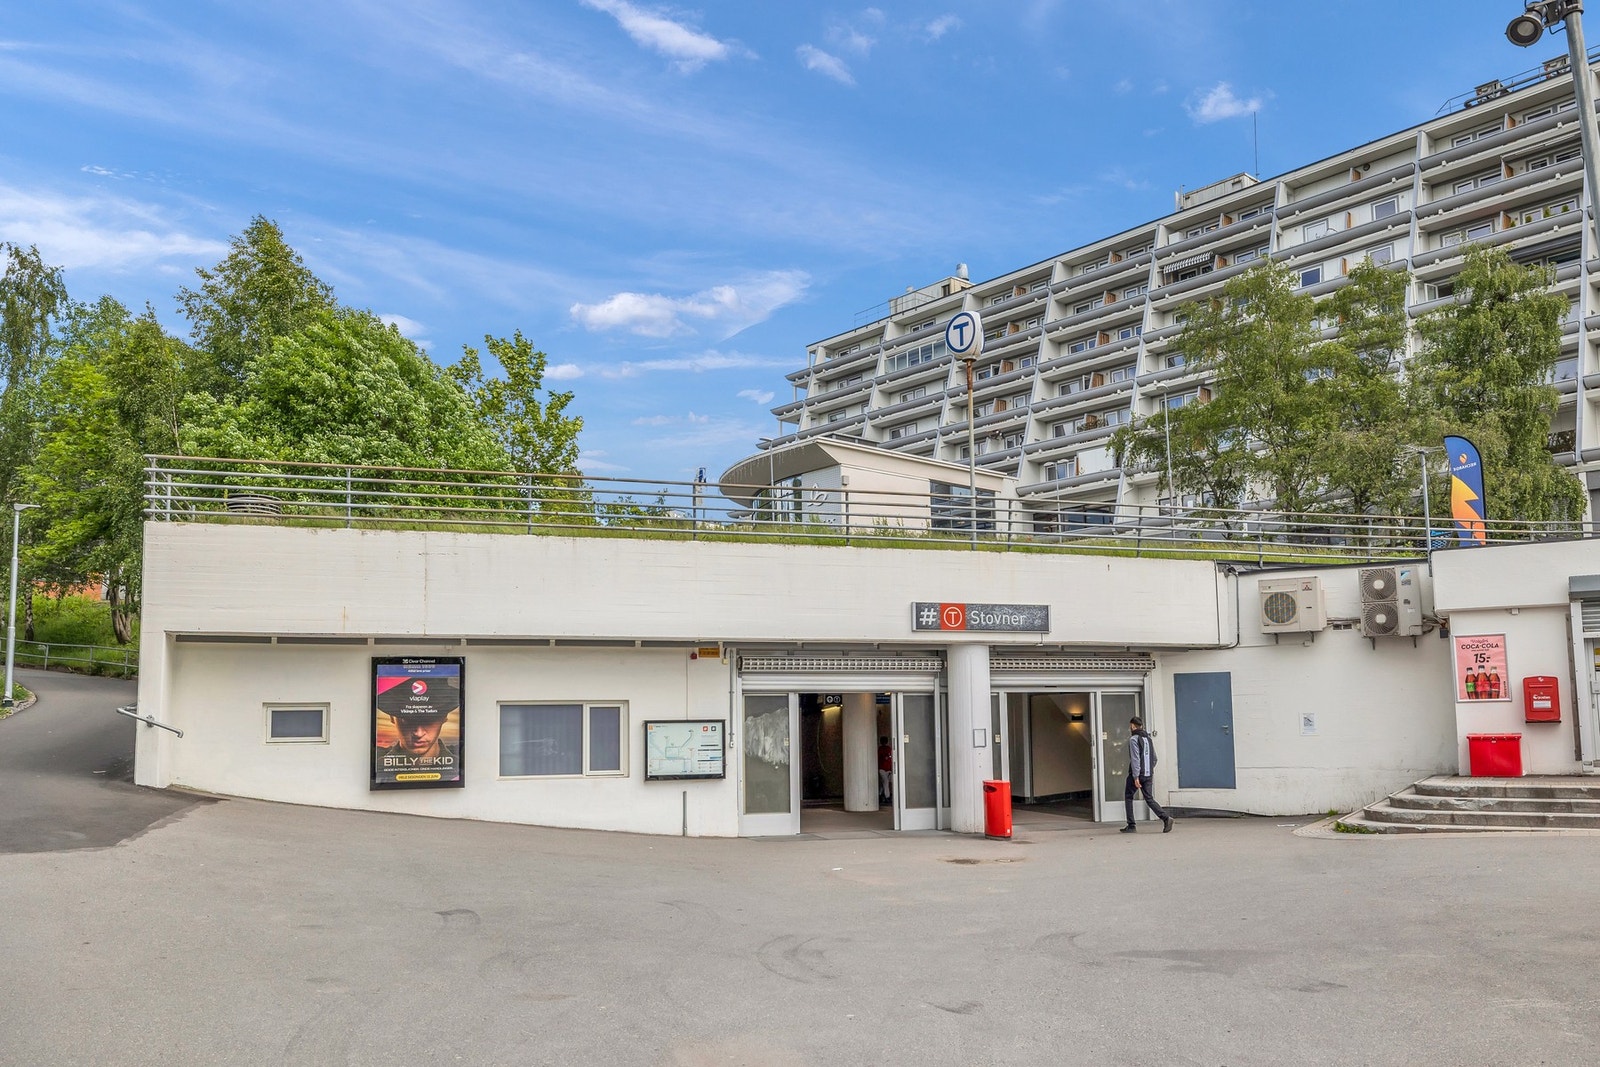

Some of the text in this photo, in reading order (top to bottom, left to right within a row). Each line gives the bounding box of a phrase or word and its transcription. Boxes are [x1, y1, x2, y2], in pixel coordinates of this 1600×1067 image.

[953, 321, 969, 347] T
[970, 610, 1027, 625] Stovner
[384, 758, 418, 766] BILLY
[433, 756, 454, 765] KID
